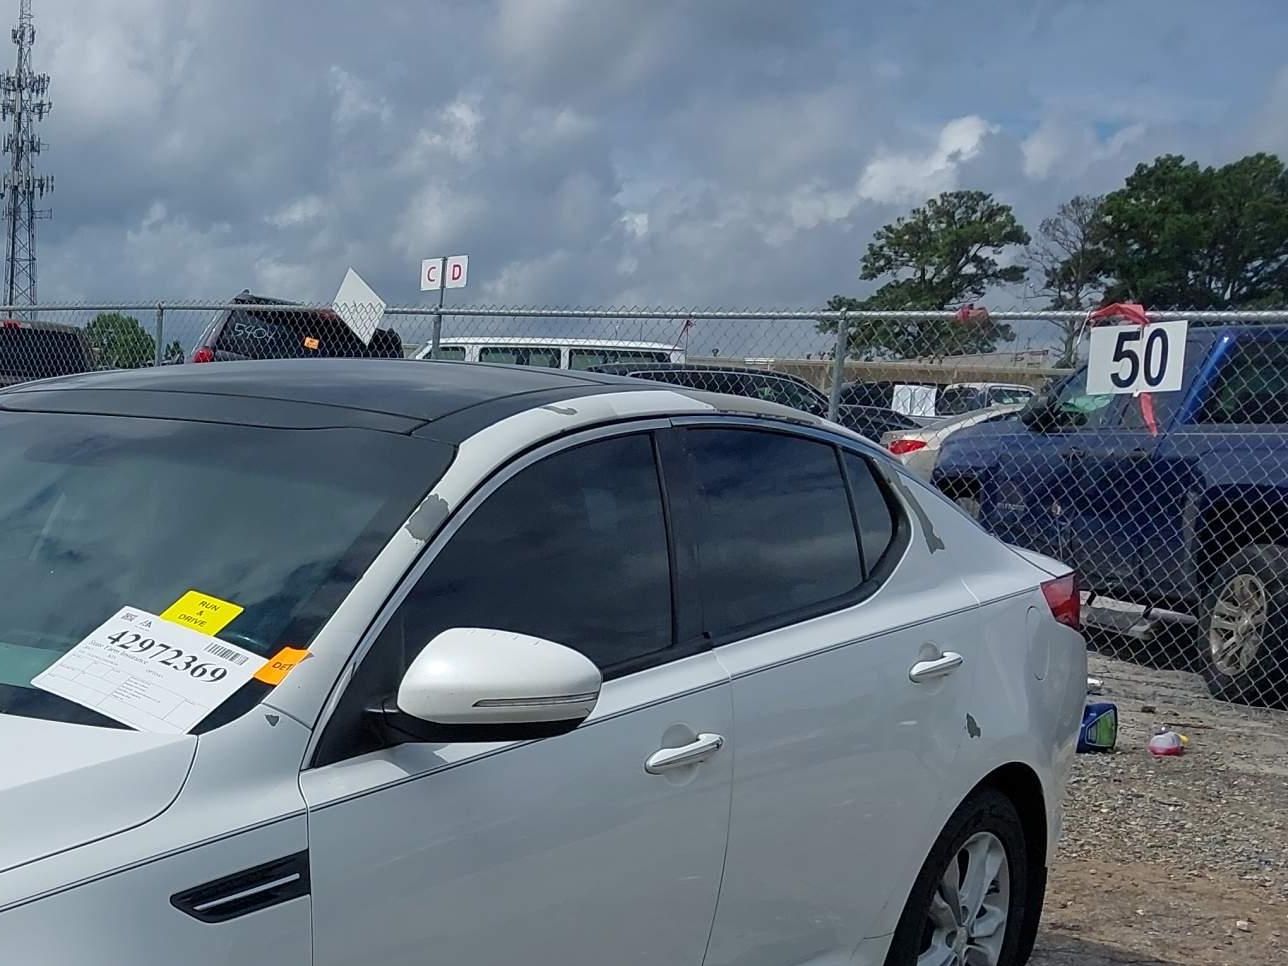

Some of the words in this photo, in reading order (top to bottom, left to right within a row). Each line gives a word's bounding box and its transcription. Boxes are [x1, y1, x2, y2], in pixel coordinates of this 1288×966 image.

[427, 266, 437, 282] C
[452, 264, 462, 281] D
[1110, 328, 1169, 388] 50
[198, 600, 220, 612] RUN
[177, 613, 207, 628] DRIVE
[108, 630, 228, 682] 42972369
